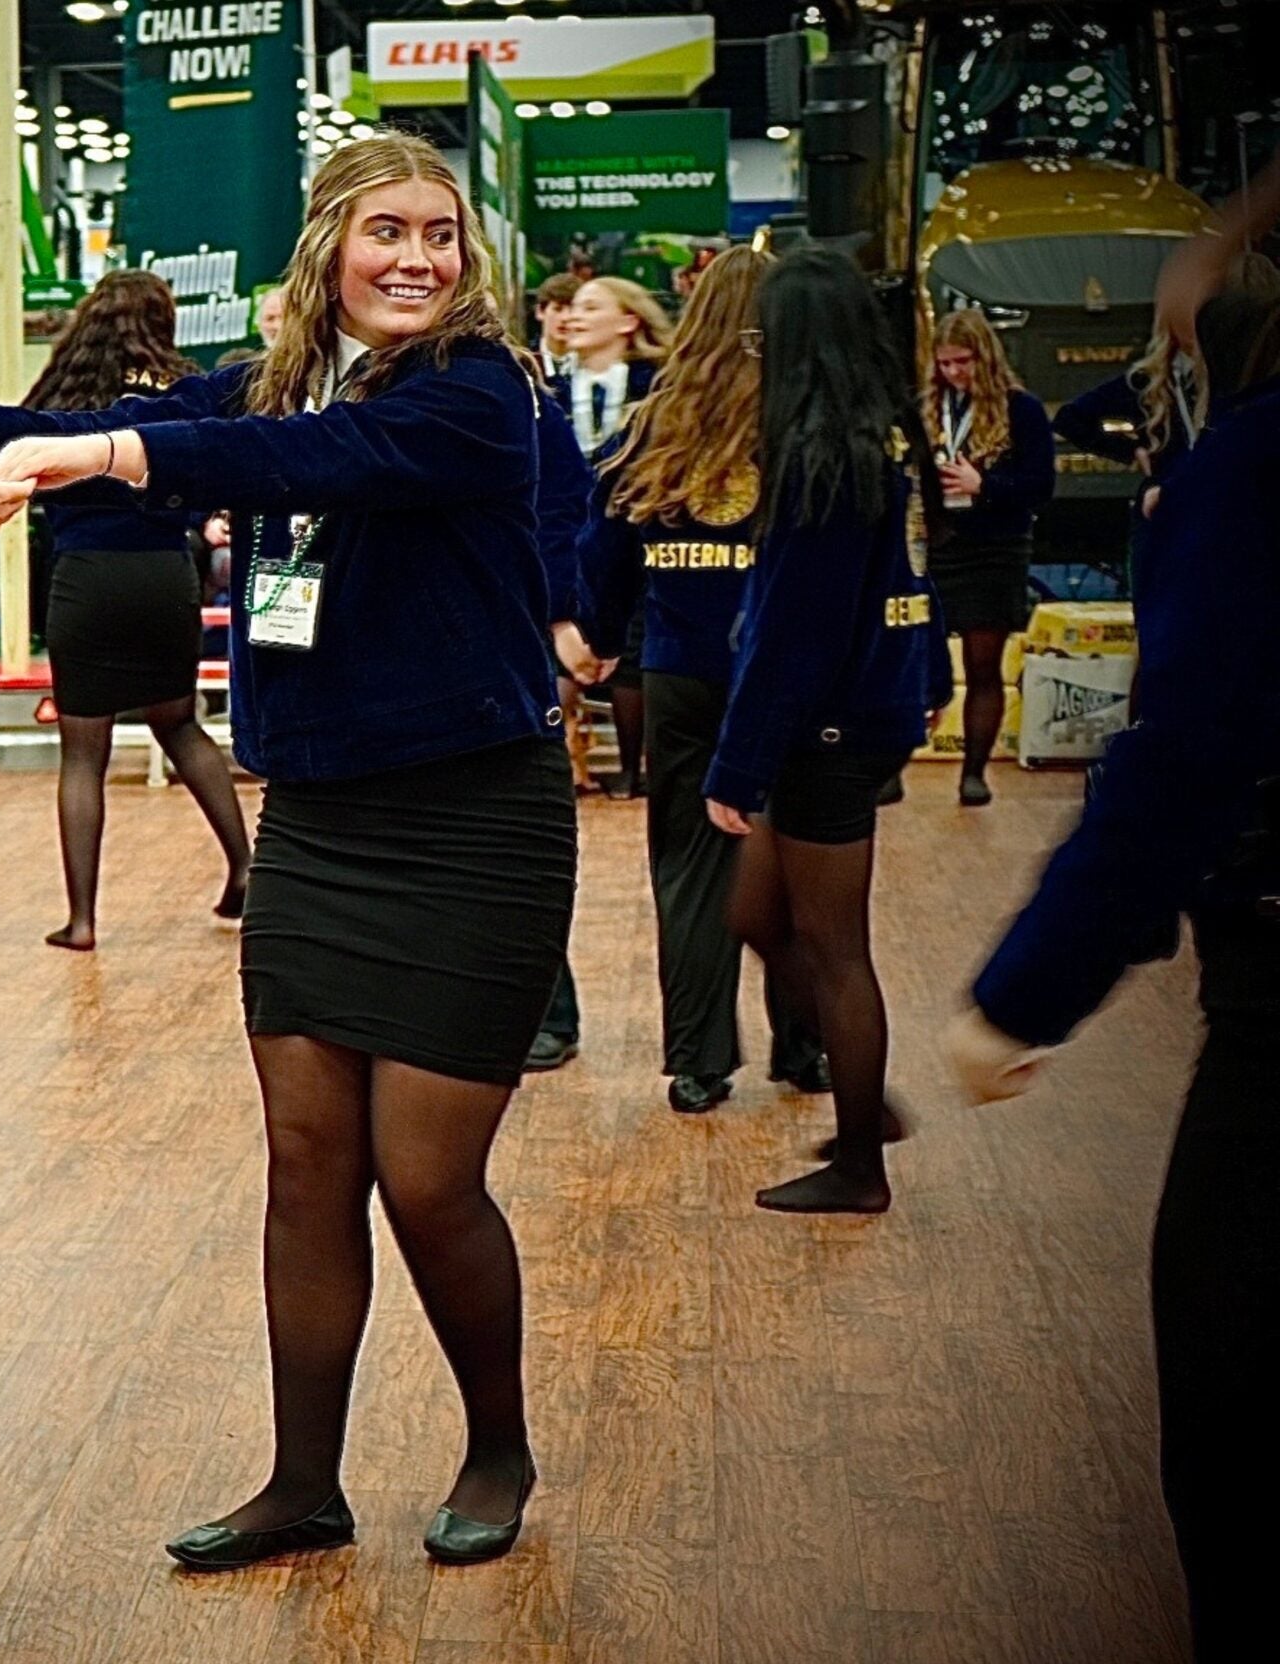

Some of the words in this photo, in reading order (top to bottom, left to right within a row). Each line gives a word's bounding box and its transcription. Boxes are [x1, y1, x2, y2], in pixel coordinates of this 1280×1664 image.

[136, 1, 283, 45] CHALLENGE
[170, 44, 251, 83] NOW!
[388, 39, 520, 66] CLAAS
[534, 176, 577, 191] THE
[578, 172, 716, 190] TECHNOLOGY
[534, 194, 577, 209] YOU
[643, 542, 730, 568] WESTERN
[734, 543, 757, 569] B
